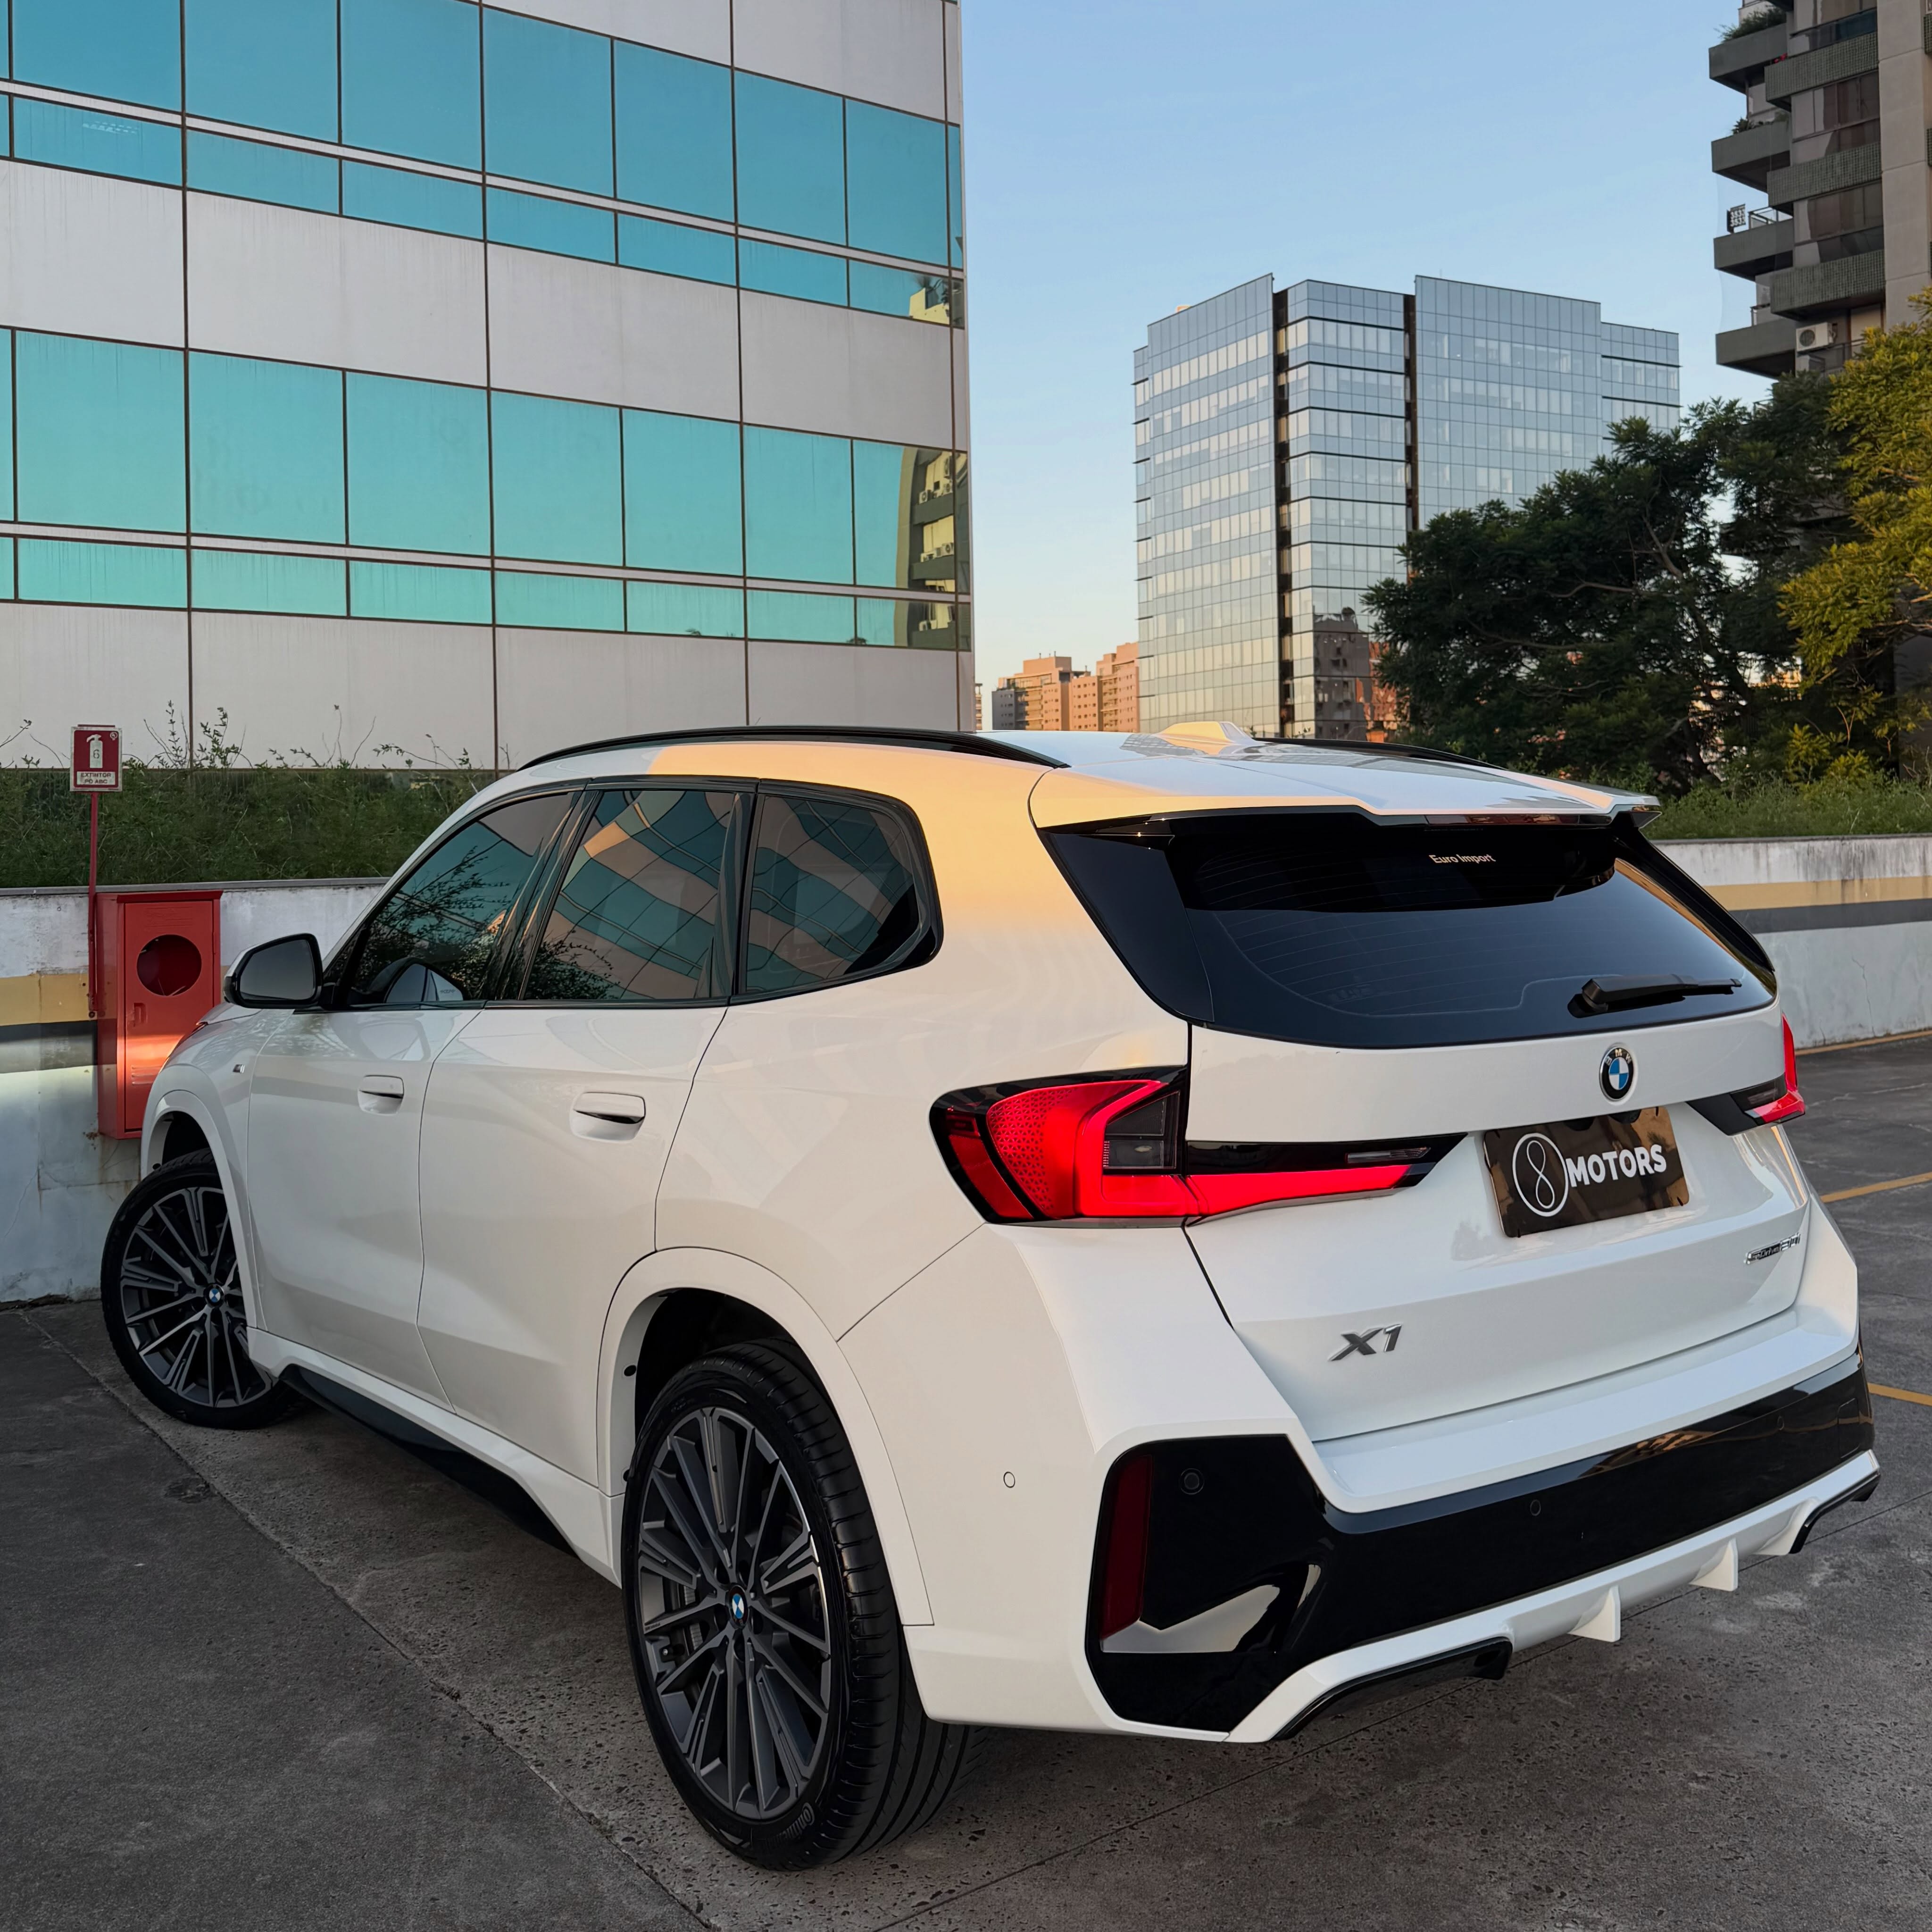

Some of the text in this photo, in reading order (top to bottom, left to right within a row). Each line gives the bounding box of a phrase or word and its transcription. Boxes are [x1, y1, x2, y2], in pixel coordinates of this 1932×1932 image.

[92, 749, 100, 759] 6
[1429, 854, 1496, 864] Euro Import
[1604, 1048, 1632, 1066] BMW
[1566, 1144, 1666, 1187] MOTORS
[1328, 1323, 1402, 1361] X1
